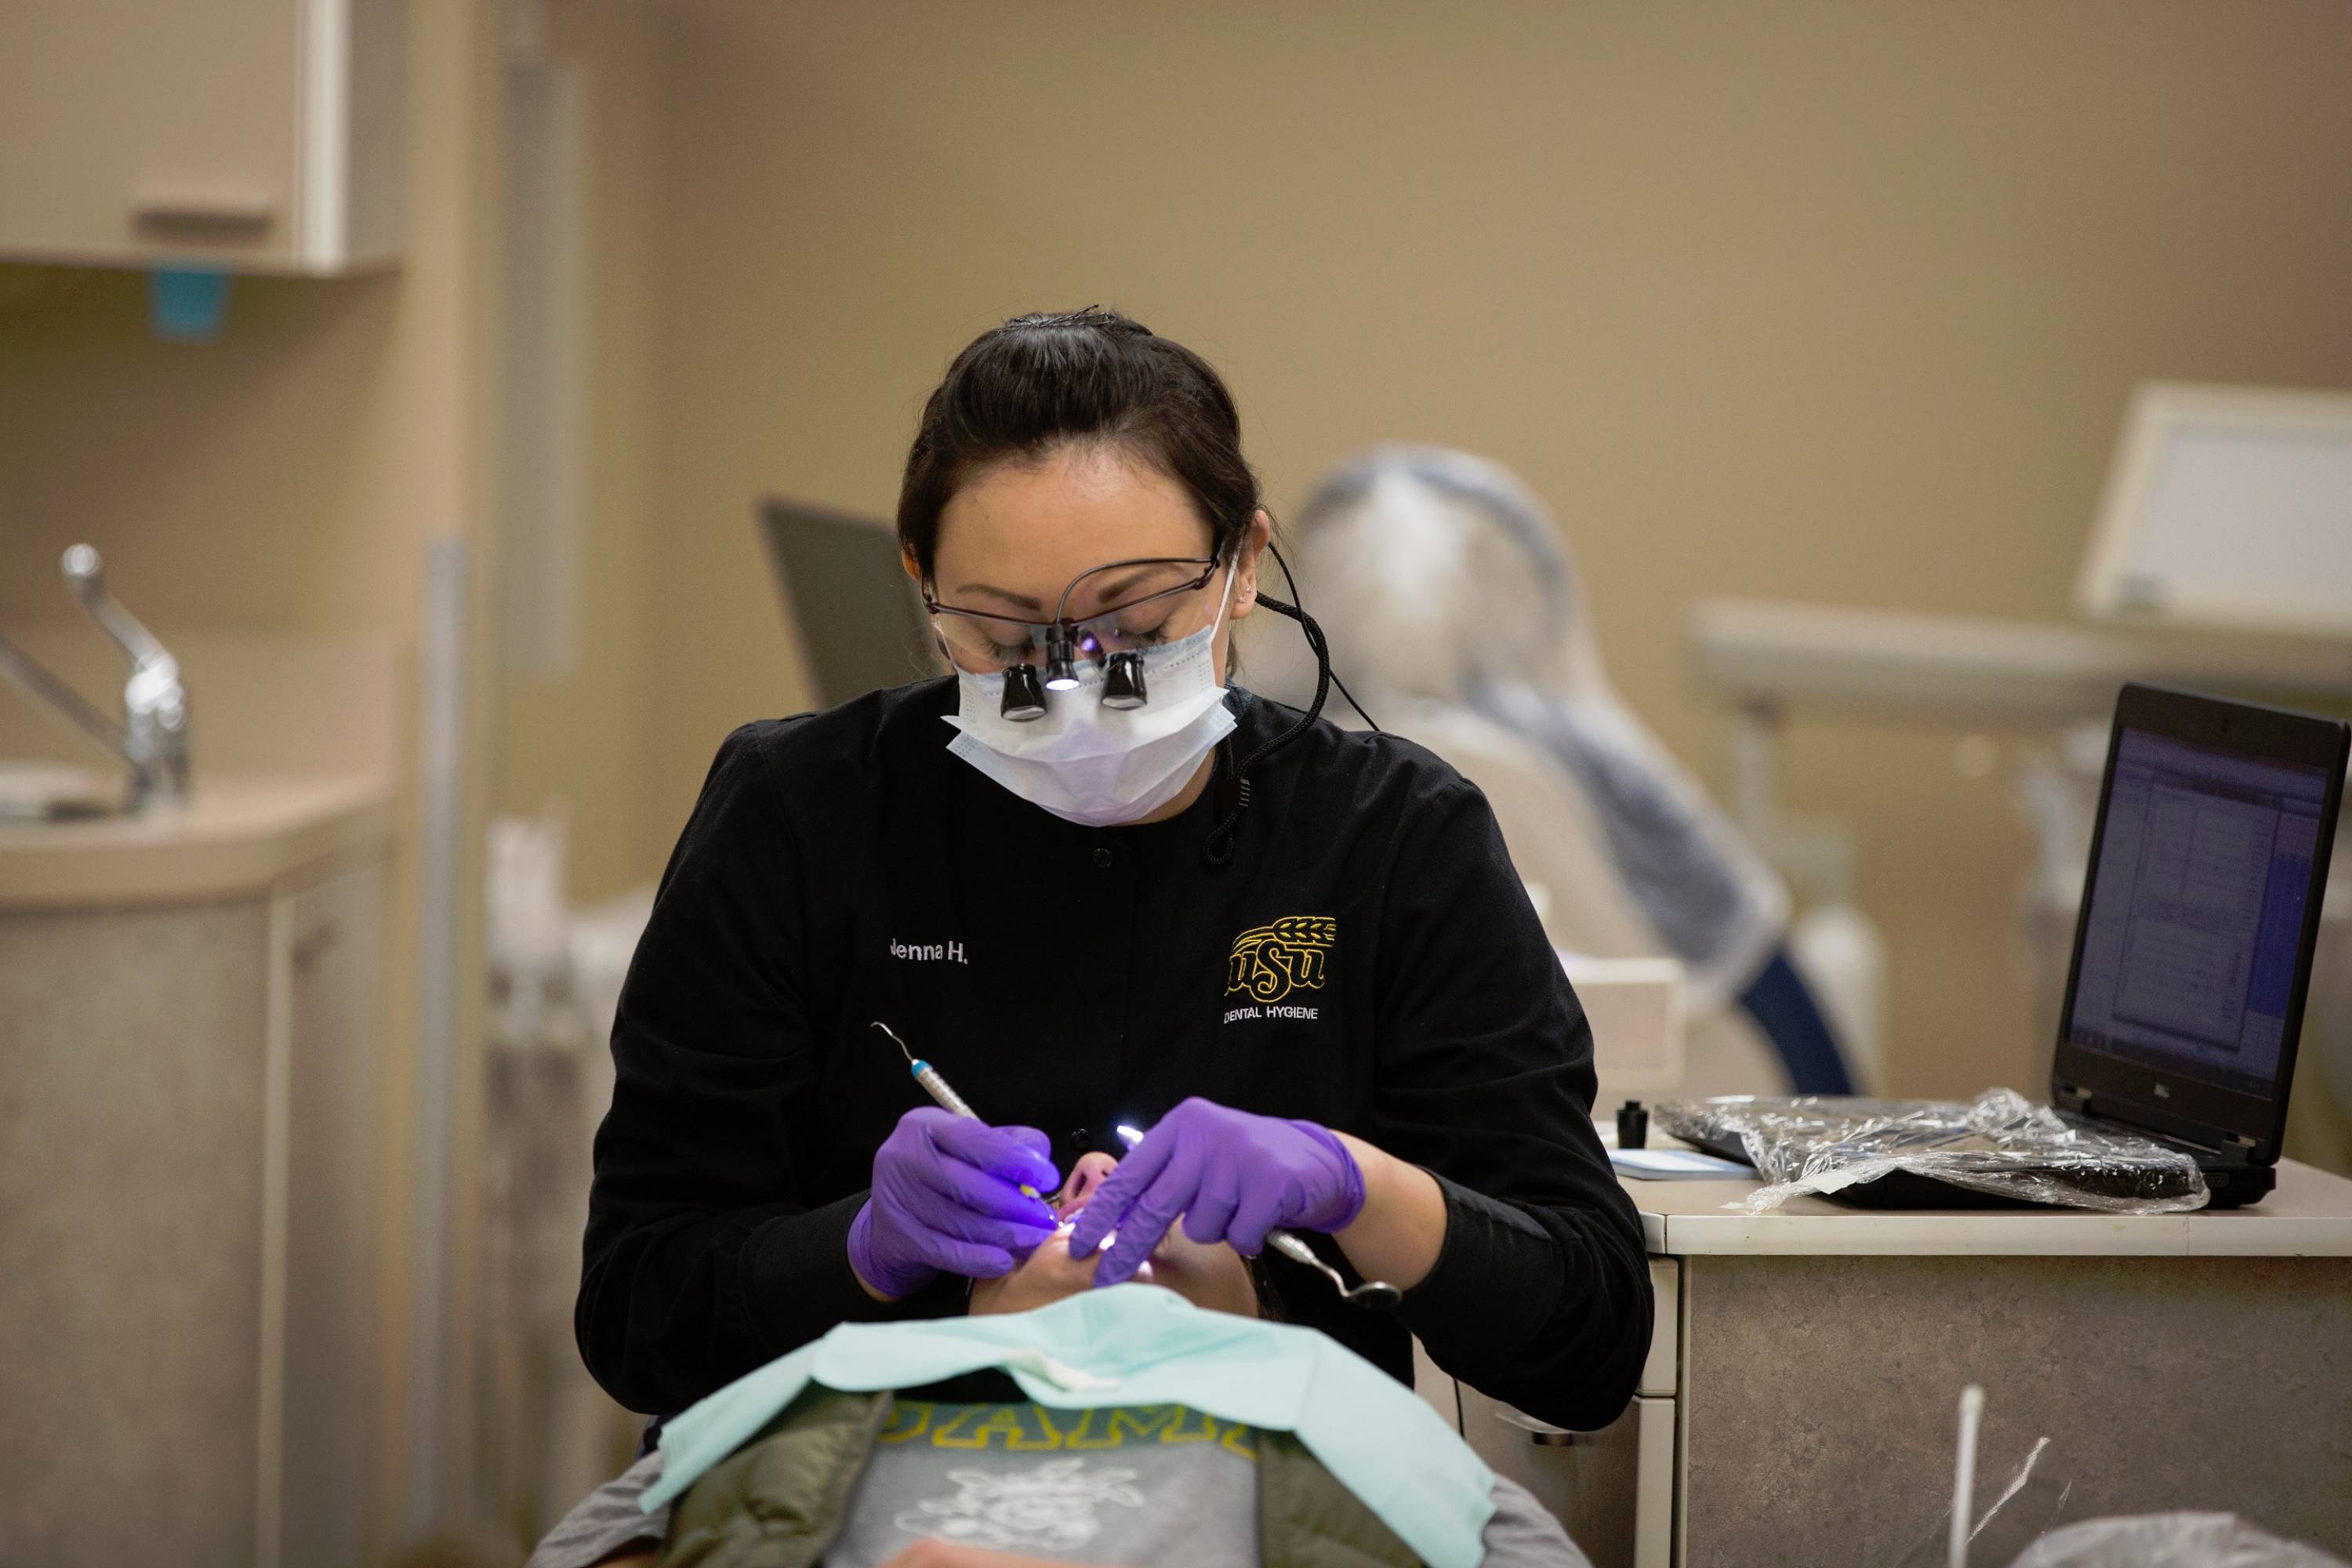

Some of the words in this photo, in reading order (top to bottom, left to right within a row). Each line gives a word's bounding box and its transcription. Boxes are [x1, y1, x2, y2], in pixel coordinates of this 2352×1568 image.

[947, 940, 969, 965] H.
[1223, 1007, 1263, 1024] DENTAL
[1266, 1005, 1319, 1020] HYGIENE
